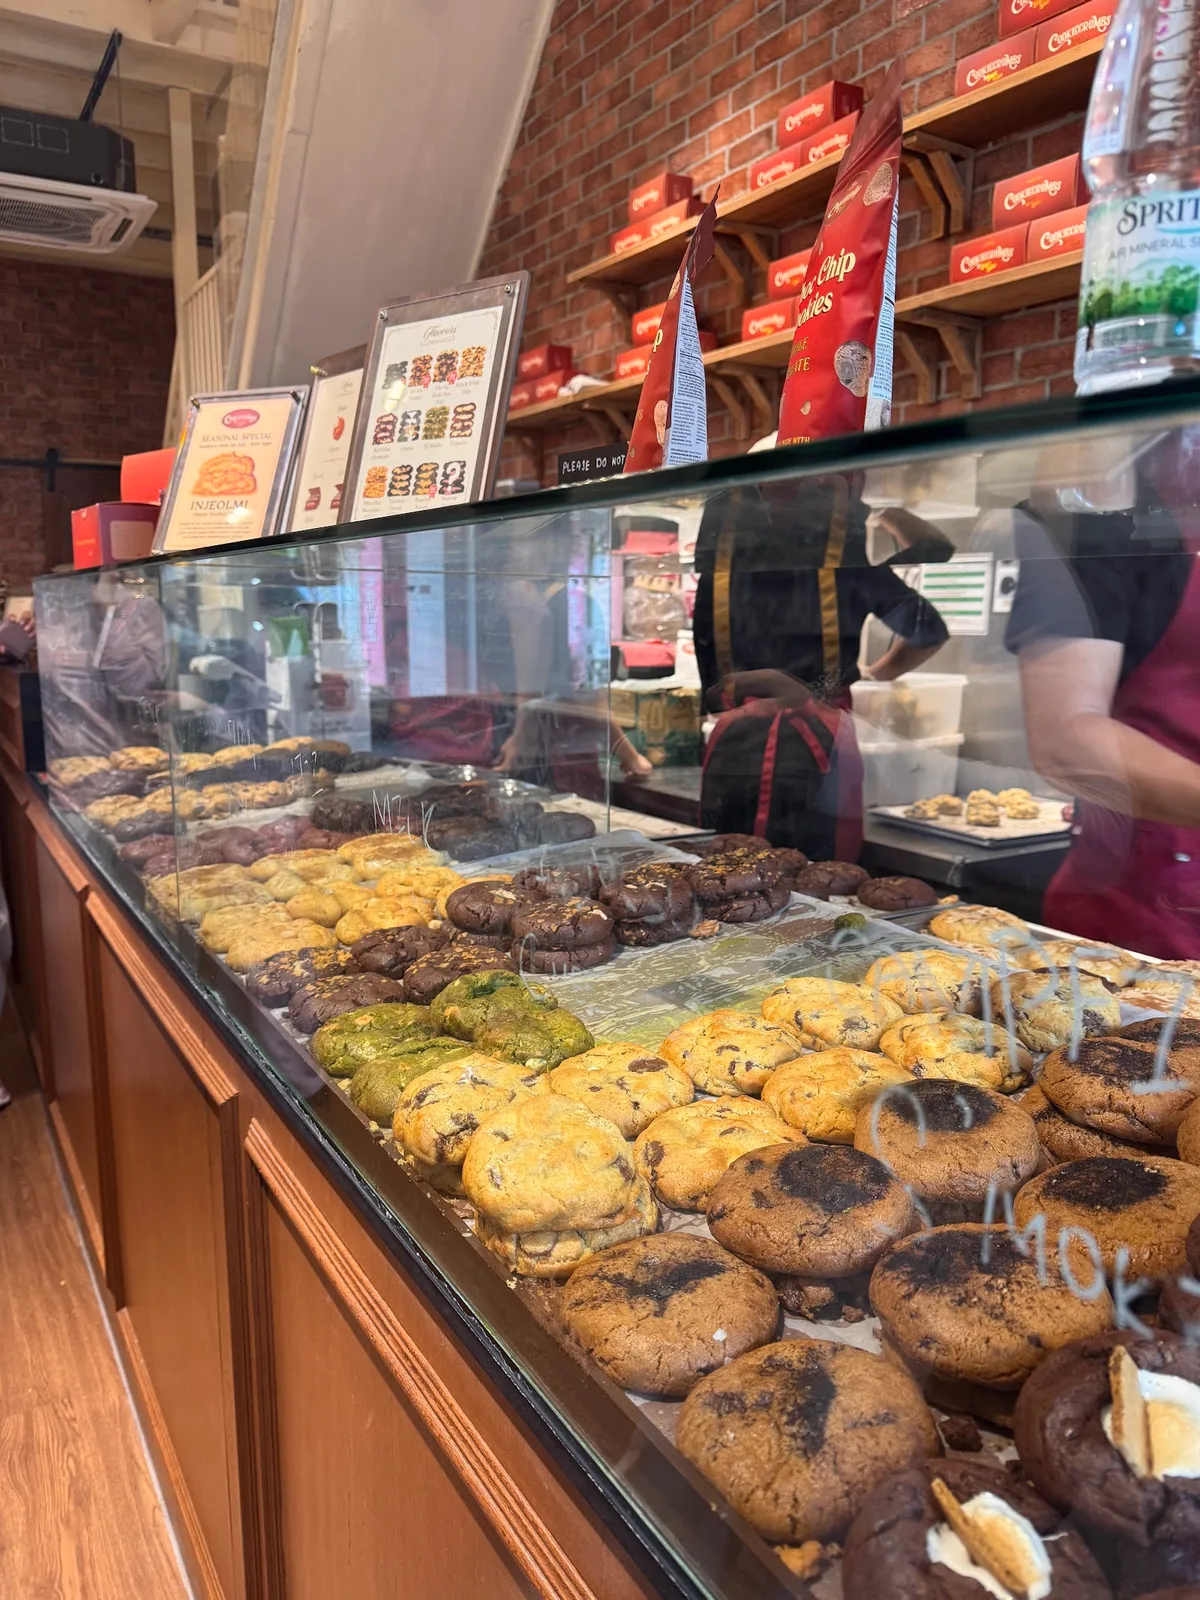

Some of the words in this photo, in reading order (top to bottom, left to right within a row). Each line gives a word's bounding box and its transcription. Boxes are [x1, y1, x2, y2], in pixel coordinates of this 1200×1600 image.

[1129, 237, 1186, 256] MINERAL
[817, 248, 856, 283] Chip
[797, 292, 834, 328] ookies
[242, 431, 273, 441] SPECIAL
[562, 459, 590, 475] PLEASE
[596, 457, 607, 469] DO
[611, 454, 626, 467] NOT
[190, 499, 249, 511] INJEOLMI
